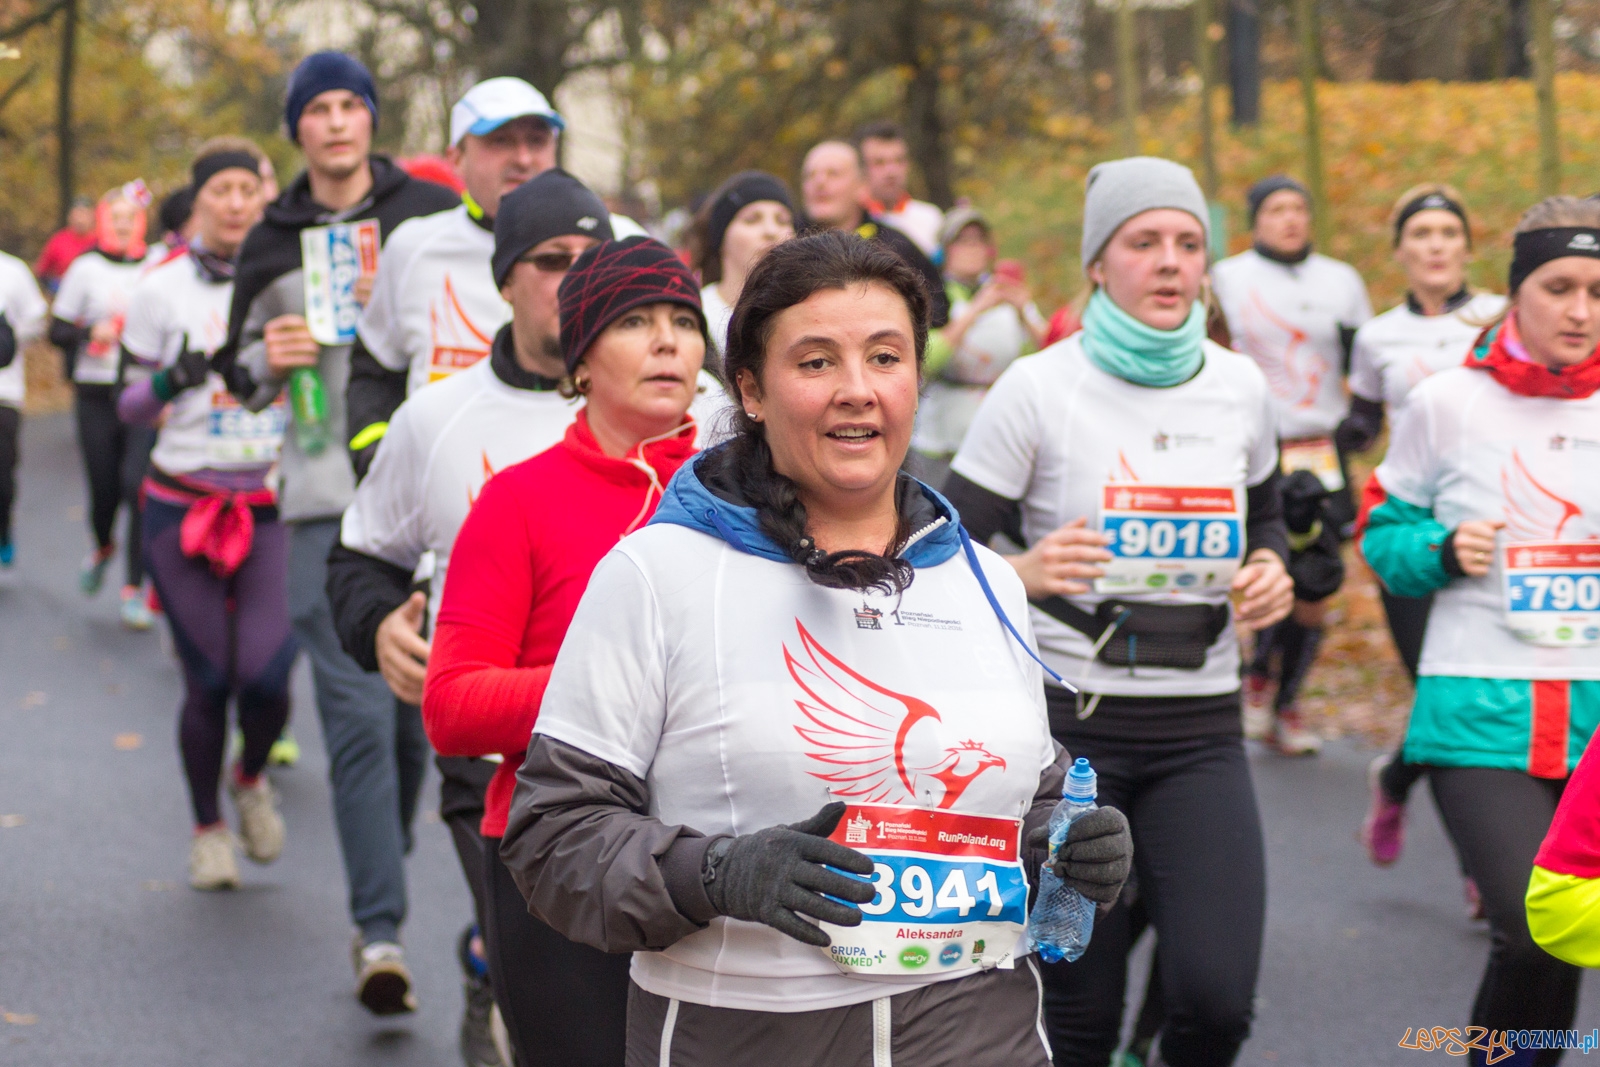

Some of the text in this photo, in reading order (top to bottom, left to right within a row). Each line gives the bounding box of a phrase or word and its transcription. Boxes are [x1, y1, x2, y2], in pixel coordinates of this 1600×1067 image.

[1119, 519, 1231, 557] 9018
[876, 821, 887, 839] 1
[938, 831, 1006, 851] RunPoland.org
[857, 862, 1004, 917] 3941
[896, 927, 963, 940] Aleksandra
[831, 945, 867, 957] GRUPA
[903, 952, 928, 964] energy
